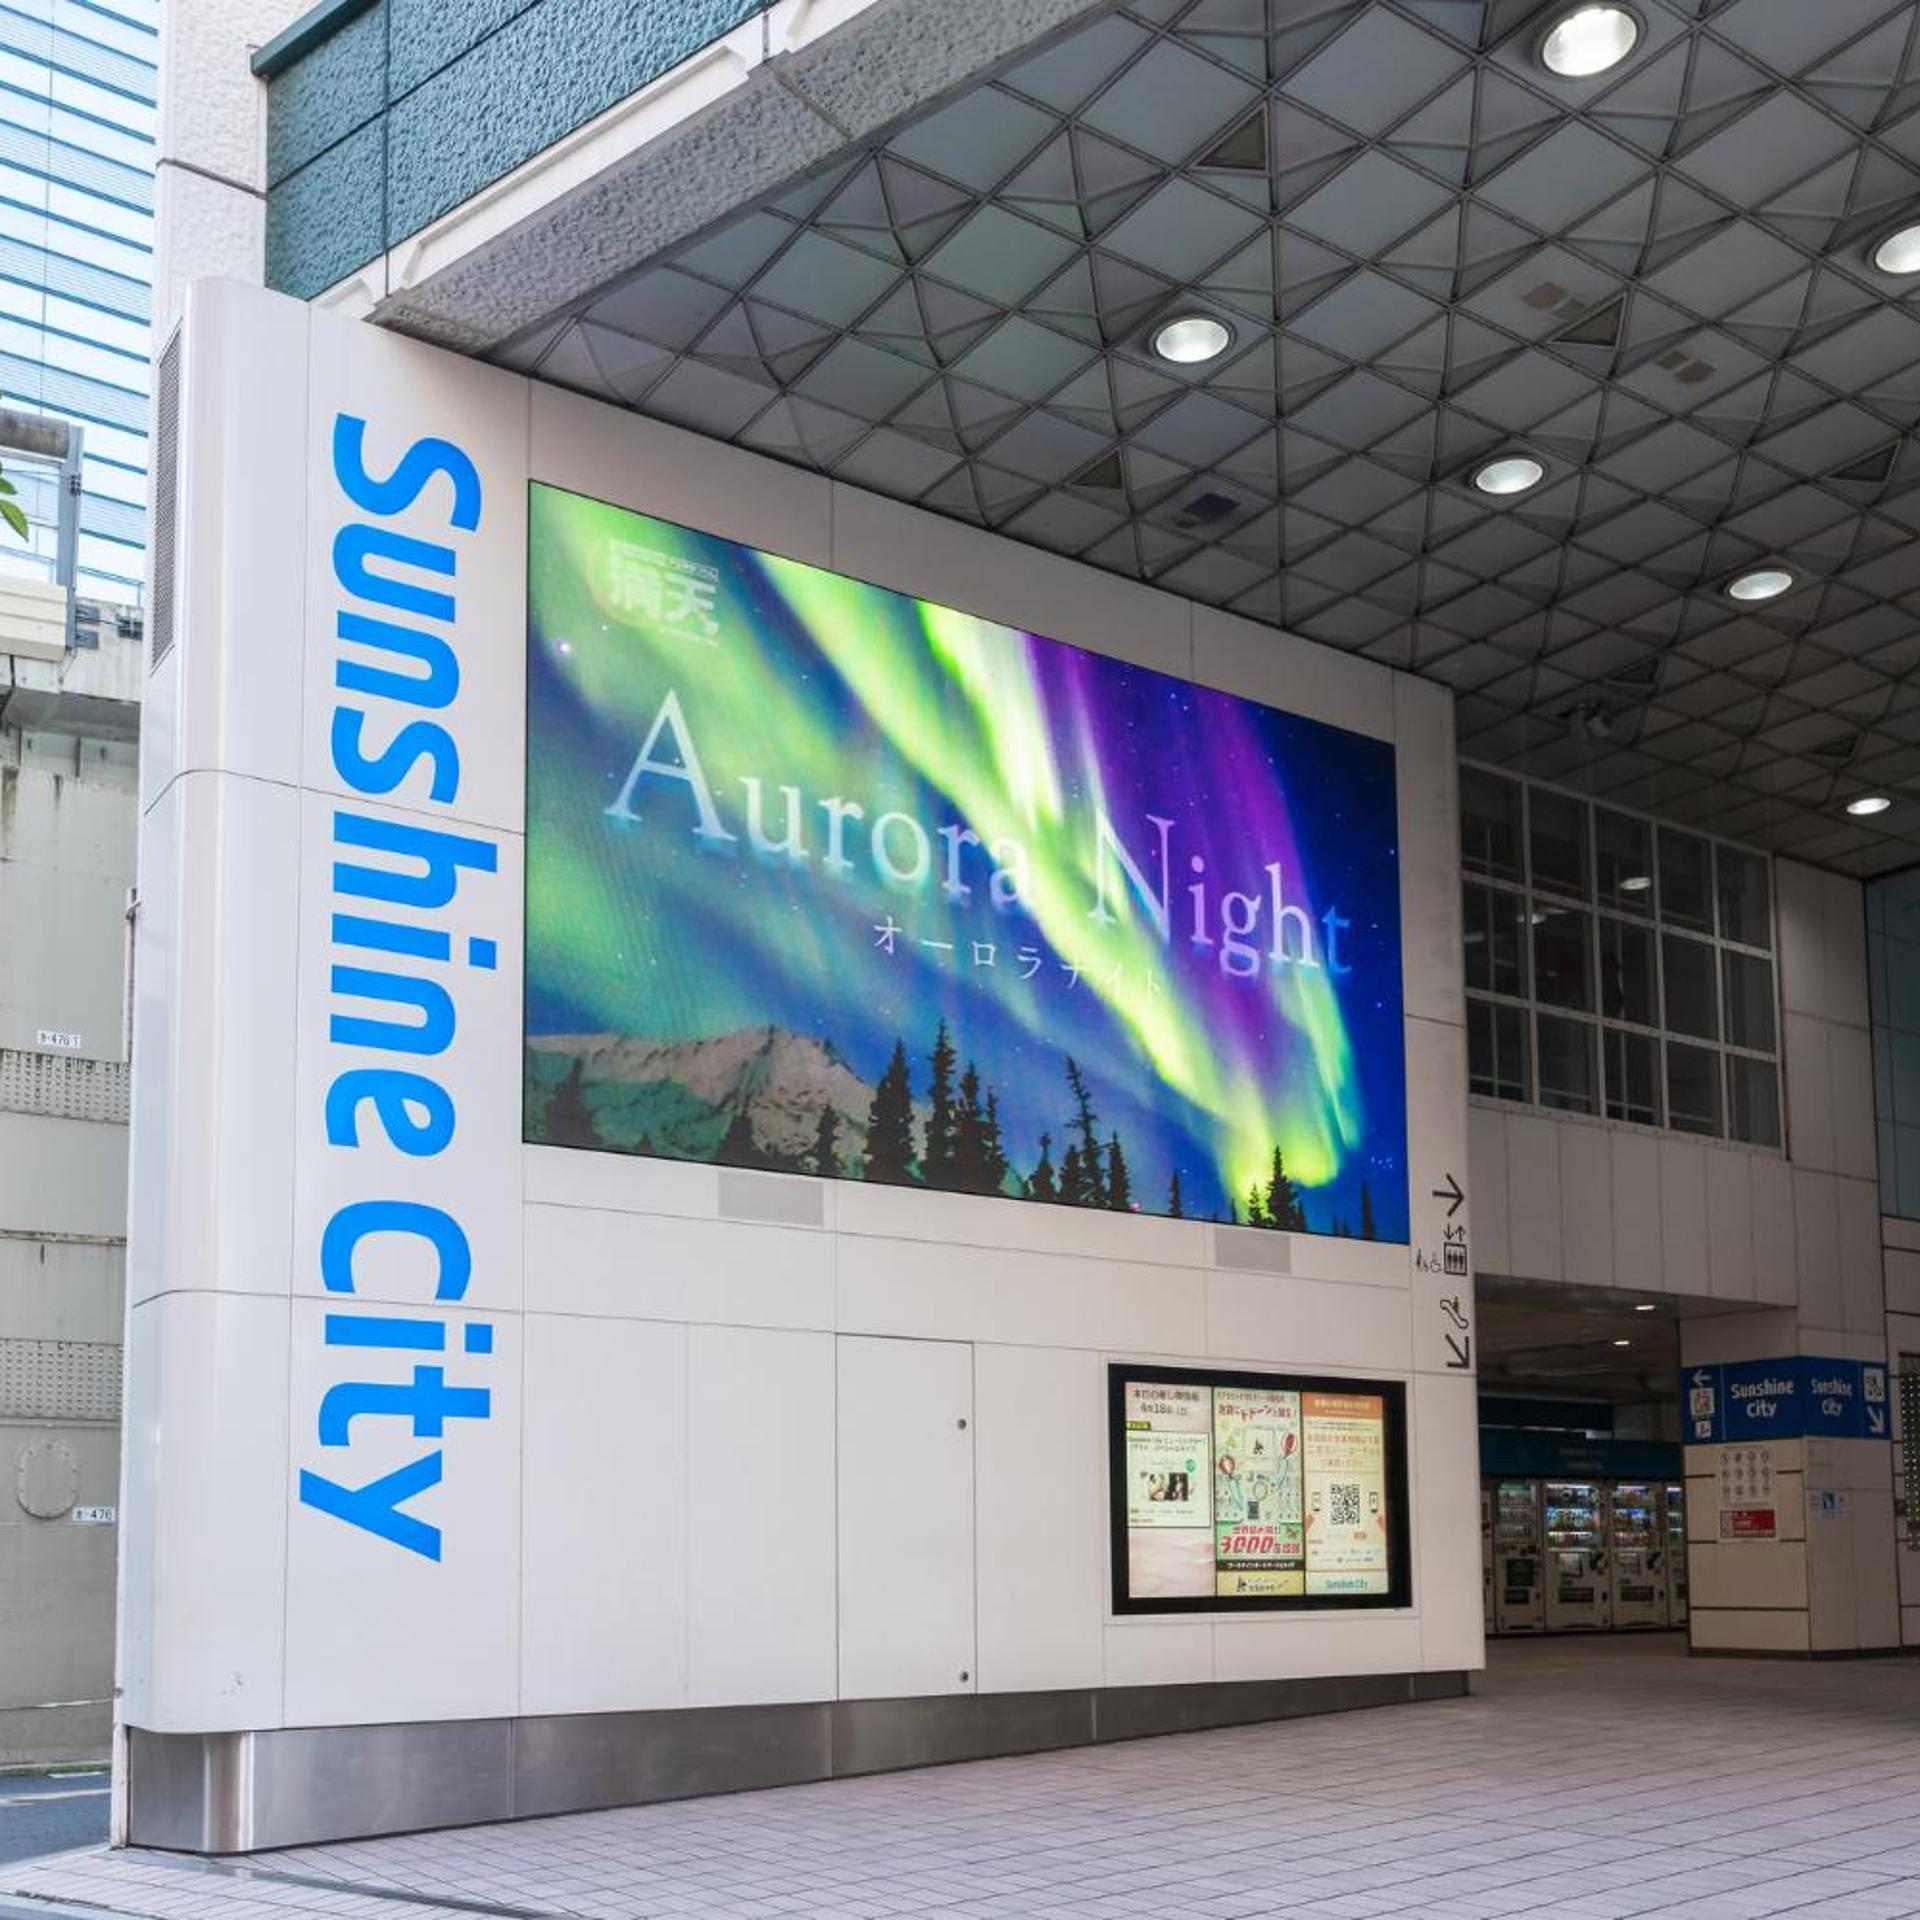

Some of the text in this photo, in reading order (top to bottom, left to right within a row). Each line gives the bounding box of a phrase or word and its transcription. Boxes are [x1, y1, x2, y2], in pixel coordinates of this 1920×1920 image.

[325, 412, 498, 1157] Sunshine
[603, 688, 1352, 978] Aurora Night
[872, 915, 1160, 992] オーロラナイト
[1731, 1378, 1794, 1399] Sunshine
